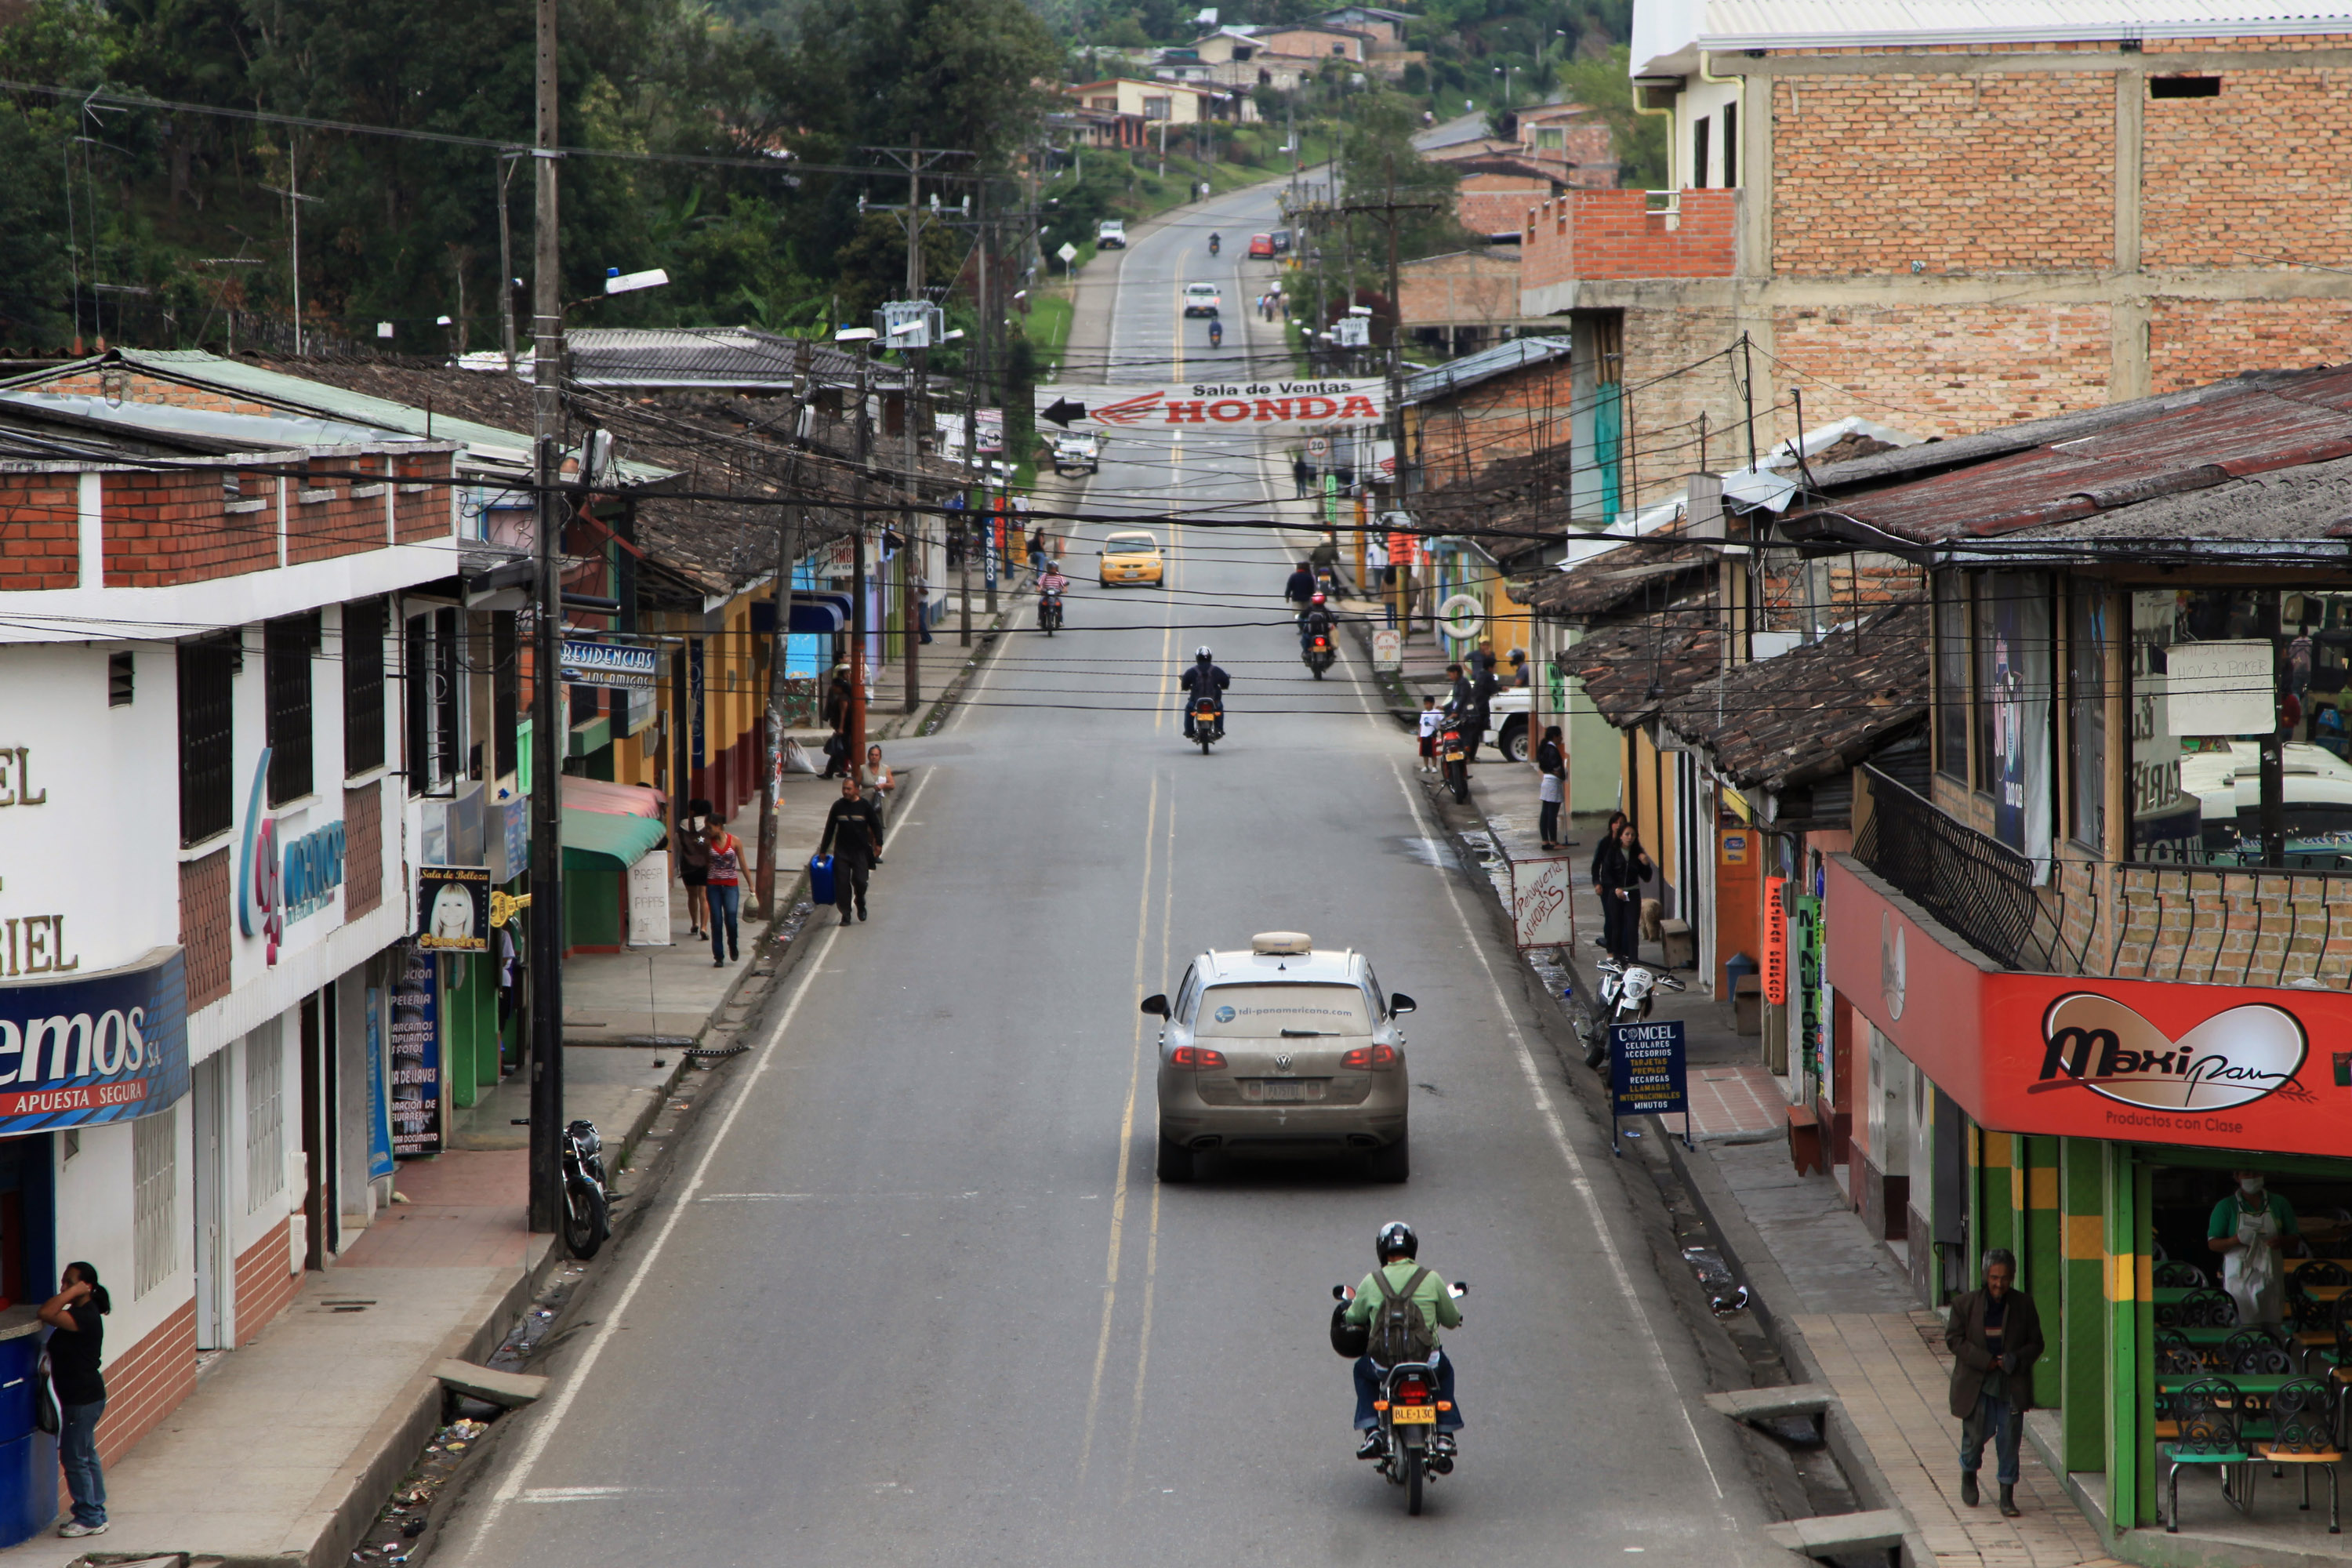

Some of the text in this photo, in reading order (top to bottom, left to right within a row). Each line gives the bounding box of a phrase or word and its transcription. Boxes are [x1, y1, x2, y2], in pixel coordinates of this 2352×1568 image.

[1192, 379, 1352, 397] Sala de Ventas
[1164, 396, 1380, 423] HONDA
[1311, 441, 1324, 451] 20
[561, 644, 652, 669] RESIDENCIAS
[2178, 665, 2203, 683] HOY
[2227, 659, 2268, 676] POKER
[587, 672, 649, 689] LOS AMIGOS
[421, 869, 489, 880] Sala de Belleza
[1769, 887, 1782, 943] TARJETAS
[1769, 950, 1781, 999] PREPAGO
[1799, 909, 1818, 1050] MINUTOS
[1239, 1006, 1353, 1017] tdi-panamericana.com
[1618, 1025, 1676, 1042] COMCEL
[397, 1044, 423, 1054] FOTOS
[1625, 1040, 1670, 1050] CELULARES
[1624, 1049, 1671, 1058] ACCESORIOS
[2038, 1026, 2194, 1081] Maxi
[1631, 1058, 1668, 1067] TARJETAS
[1632, 1066, 1666, 1075] PREPAGO
[1630, 1075, 1669, 1084] RECARGAS
[1629, 1083, 1671, 1093] LLAMADAS
[14, 1081, 142, 1113] APUESTA SEGURA
[1620, 1091, 1681, 1102] INTERNACIONALES
[424, 1099, 436, 1109] DE
[1634, 1101, 1668, 1110] MINUTOS
[2106, 1111, 2244, 1134] Productos con Clase
